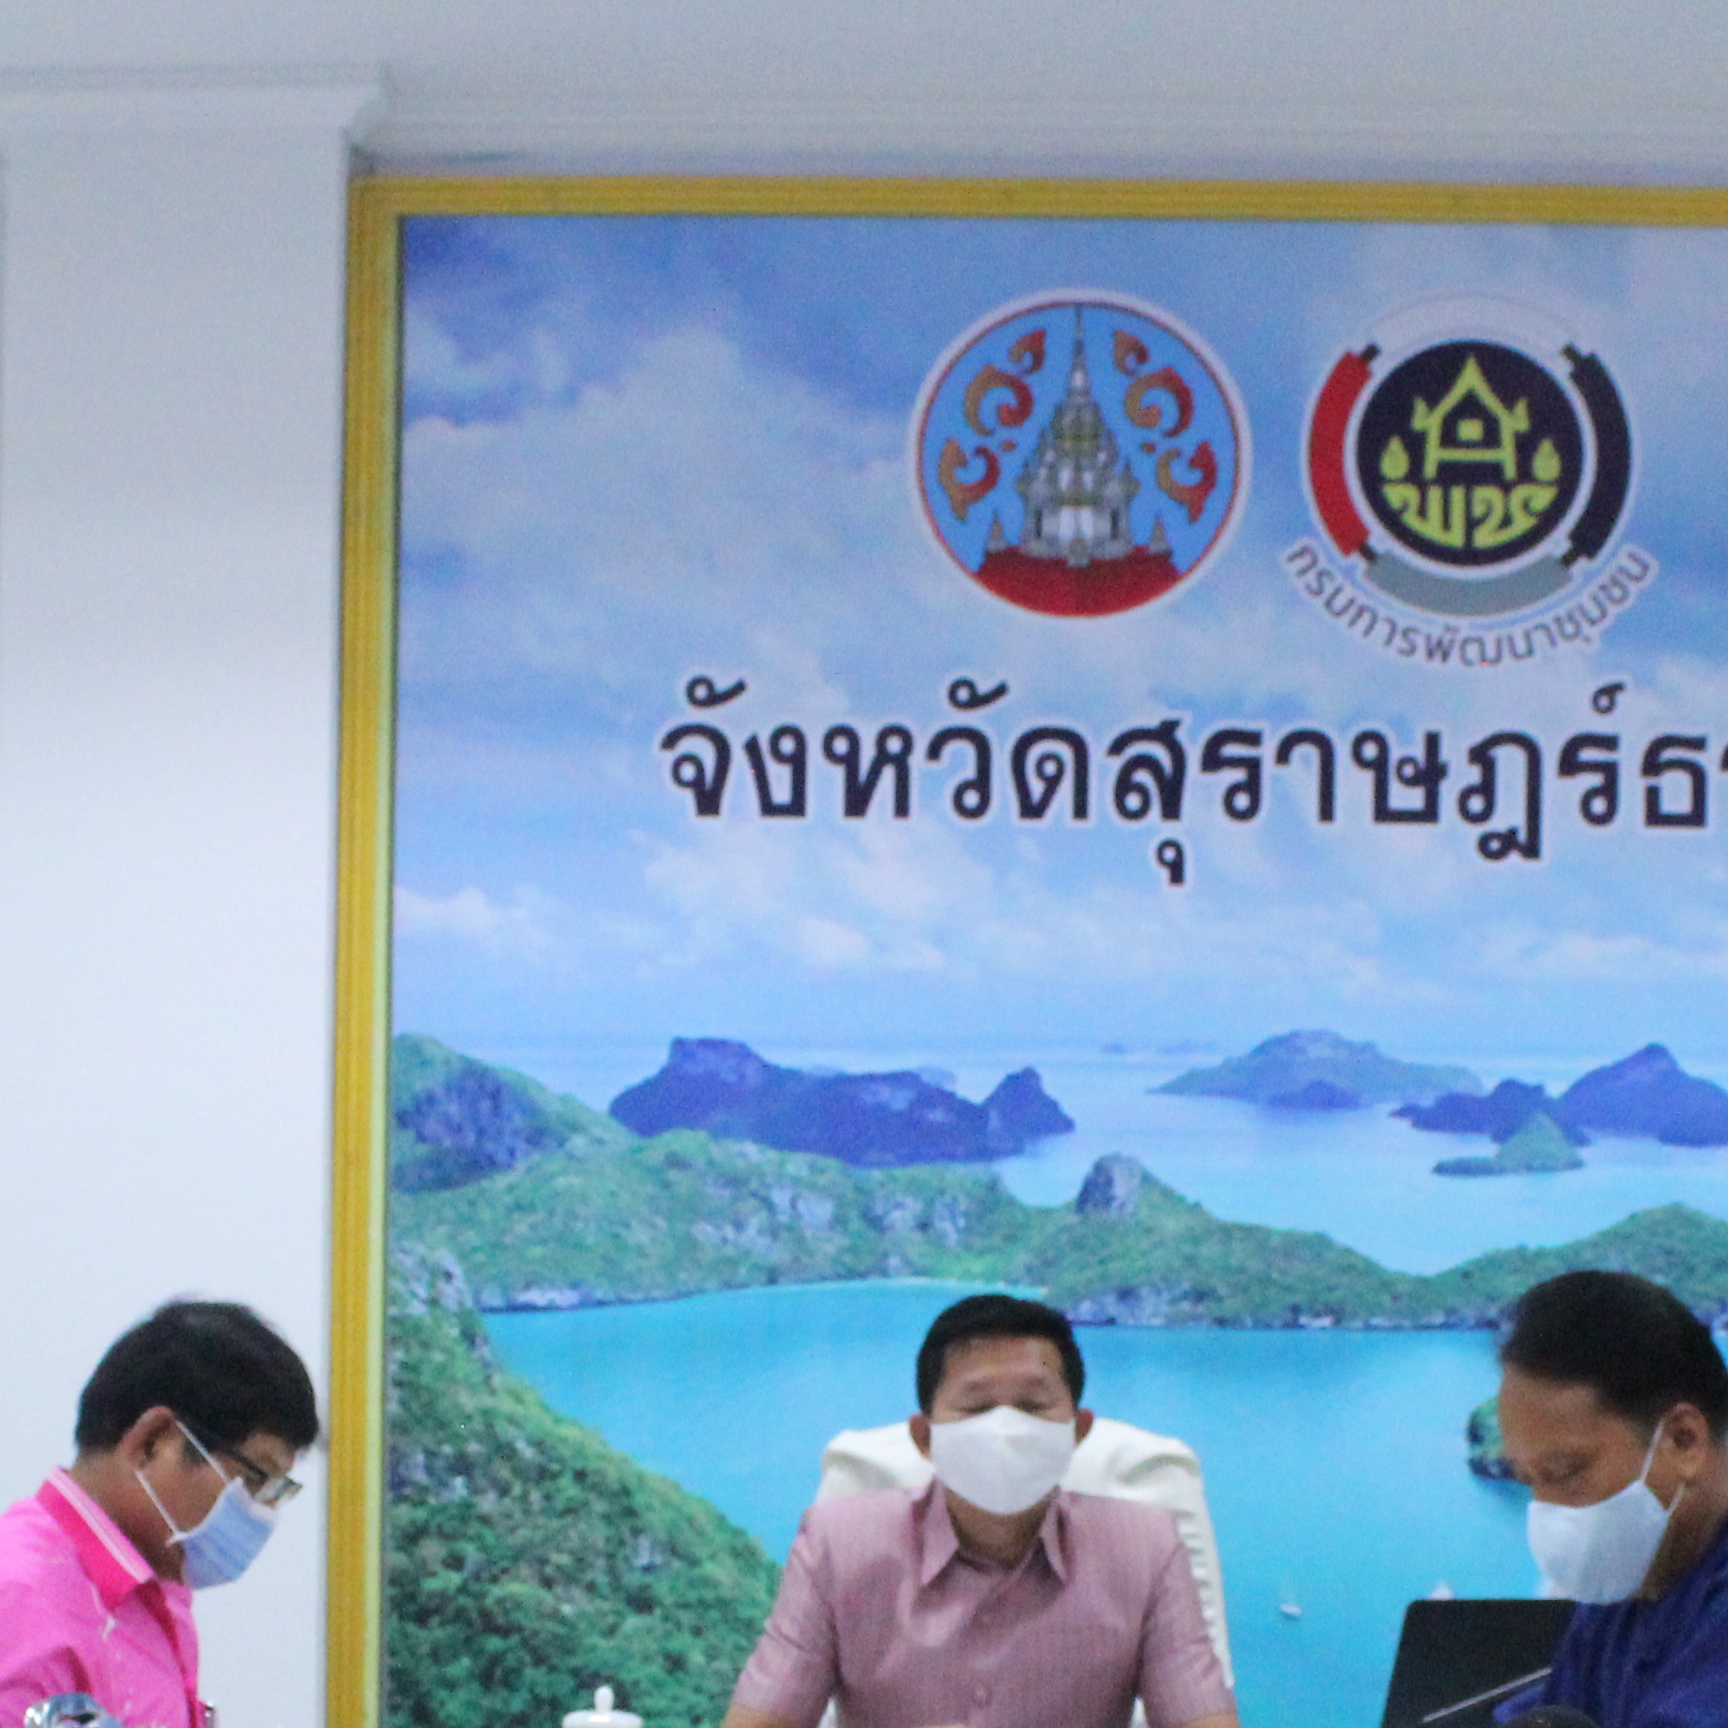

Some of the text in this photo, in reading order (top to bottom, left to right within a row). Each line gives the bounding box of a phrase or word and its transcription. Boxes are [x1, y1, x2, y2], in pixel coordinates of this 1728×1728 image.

[1286, 544, 1653, 667] กรมการพัฒนาชุมชน
